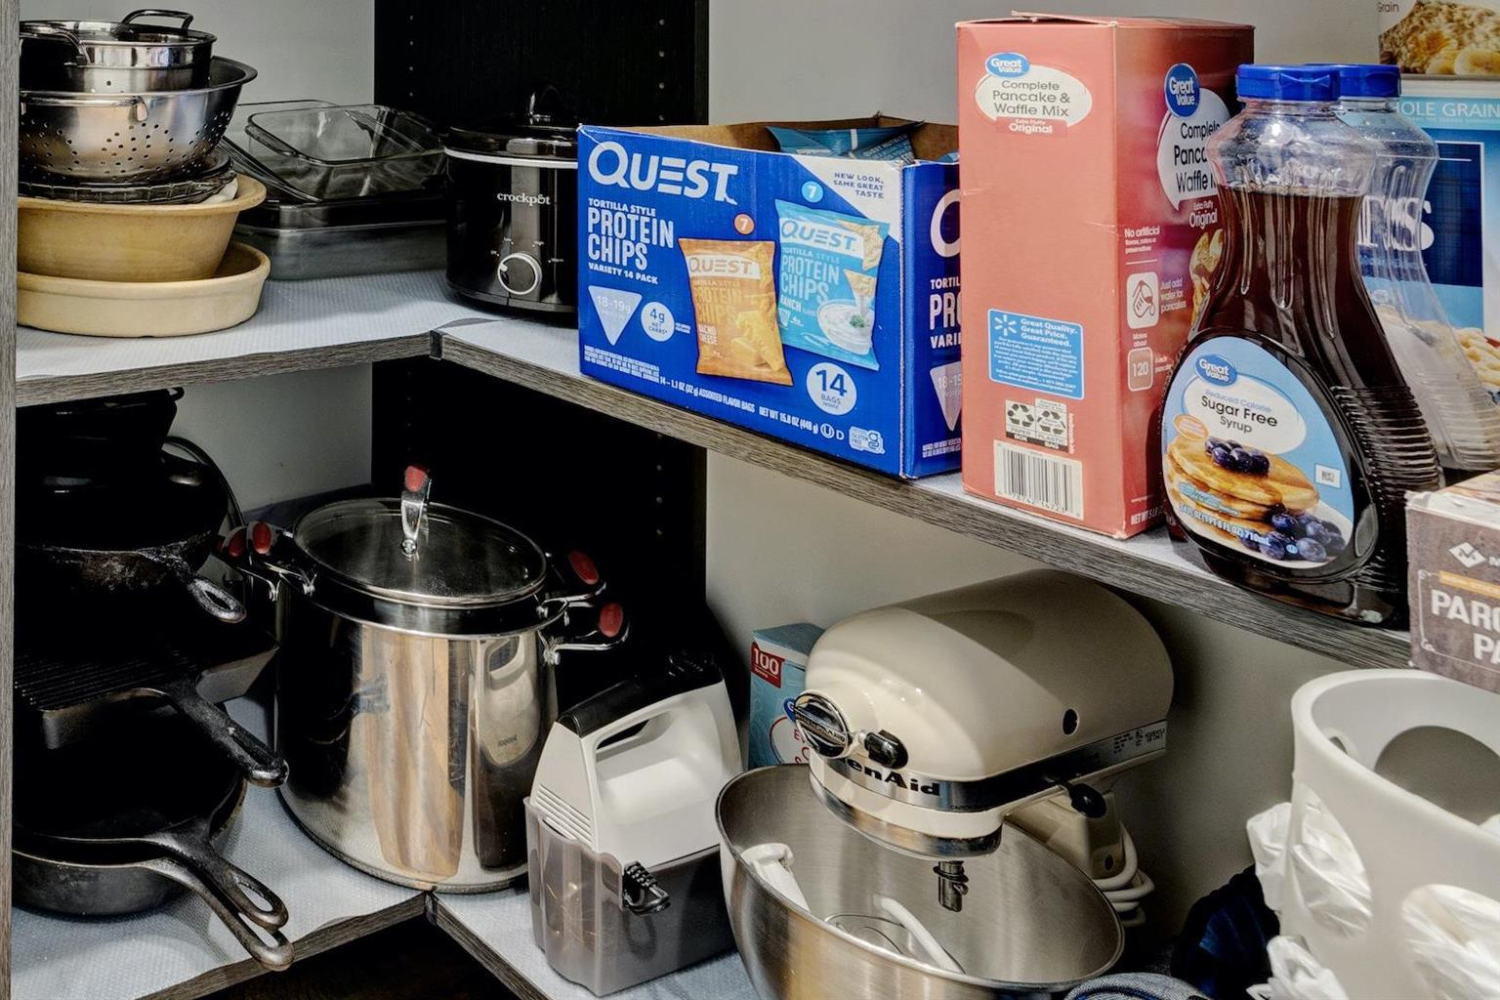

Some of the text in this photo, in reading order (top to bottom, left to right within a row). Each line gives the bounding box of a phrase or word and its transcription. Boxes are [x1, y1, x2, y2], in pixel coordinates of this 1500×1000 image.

[990, 57, 1023, 69] Great
[1001, 80, 1060, 91] Complete
[1168, 76, 1195, 96] Great
[992, 90, 1071, 104] Pancake &
[1176, 93, 1196, 107] Value
[993, 103, 1070, 117] Waffle Mix
[1009, 122, 1053, 135] Original
[588, 140, 739, 206] QUEST
[834, 172, 884, 184] NEW LOOK,
[833, 180, 884, 191] SAME GREAT
[1176, 169, 1209, 194] Waffle
[497, 192, 551, 207] crockpot
[808, 186, 816, 198] 7
[855, 189, 884, 199] TASTE
[588, 197, 657, 217] TORTILLA STYLE
[588, 207, 674, 249] PROTEIN
[739, 218, 748, 231] 7
[1188, 209, 1219, 231] Original
[780, 220, 857, 251] QUEST
[1124, 227, 1135, 239] No
[588, 233, 648, 271] CHIPS
[588, 261, 658, 285] VARIETY 14 PACK
[688, 257, 752, 274] QUEST
[781, 255, 840, 286] PROTEIN
[780, 272, 830, 304] CHIPS
[649, 307, 666, 324] 4g
[1020, 318, 1043, 328] Great
[1020, 325, 1043, 336] Great
[1132, 361, 1149, 378] 120
[1199, 358, 1230, 376] Great
[815, 368, 848, 397] 14
[1205, 370, 1230, 382] Value
[741, 400, 756, 413] BAGS
[820, 393, 842, 405] BAGS
[759, 406, 770, 418] NET
[1201, 395, 1278, 427] Sugar Free
[1219, 415, 1253, 434] Syrup
[753, 647, 779, 676] 100
